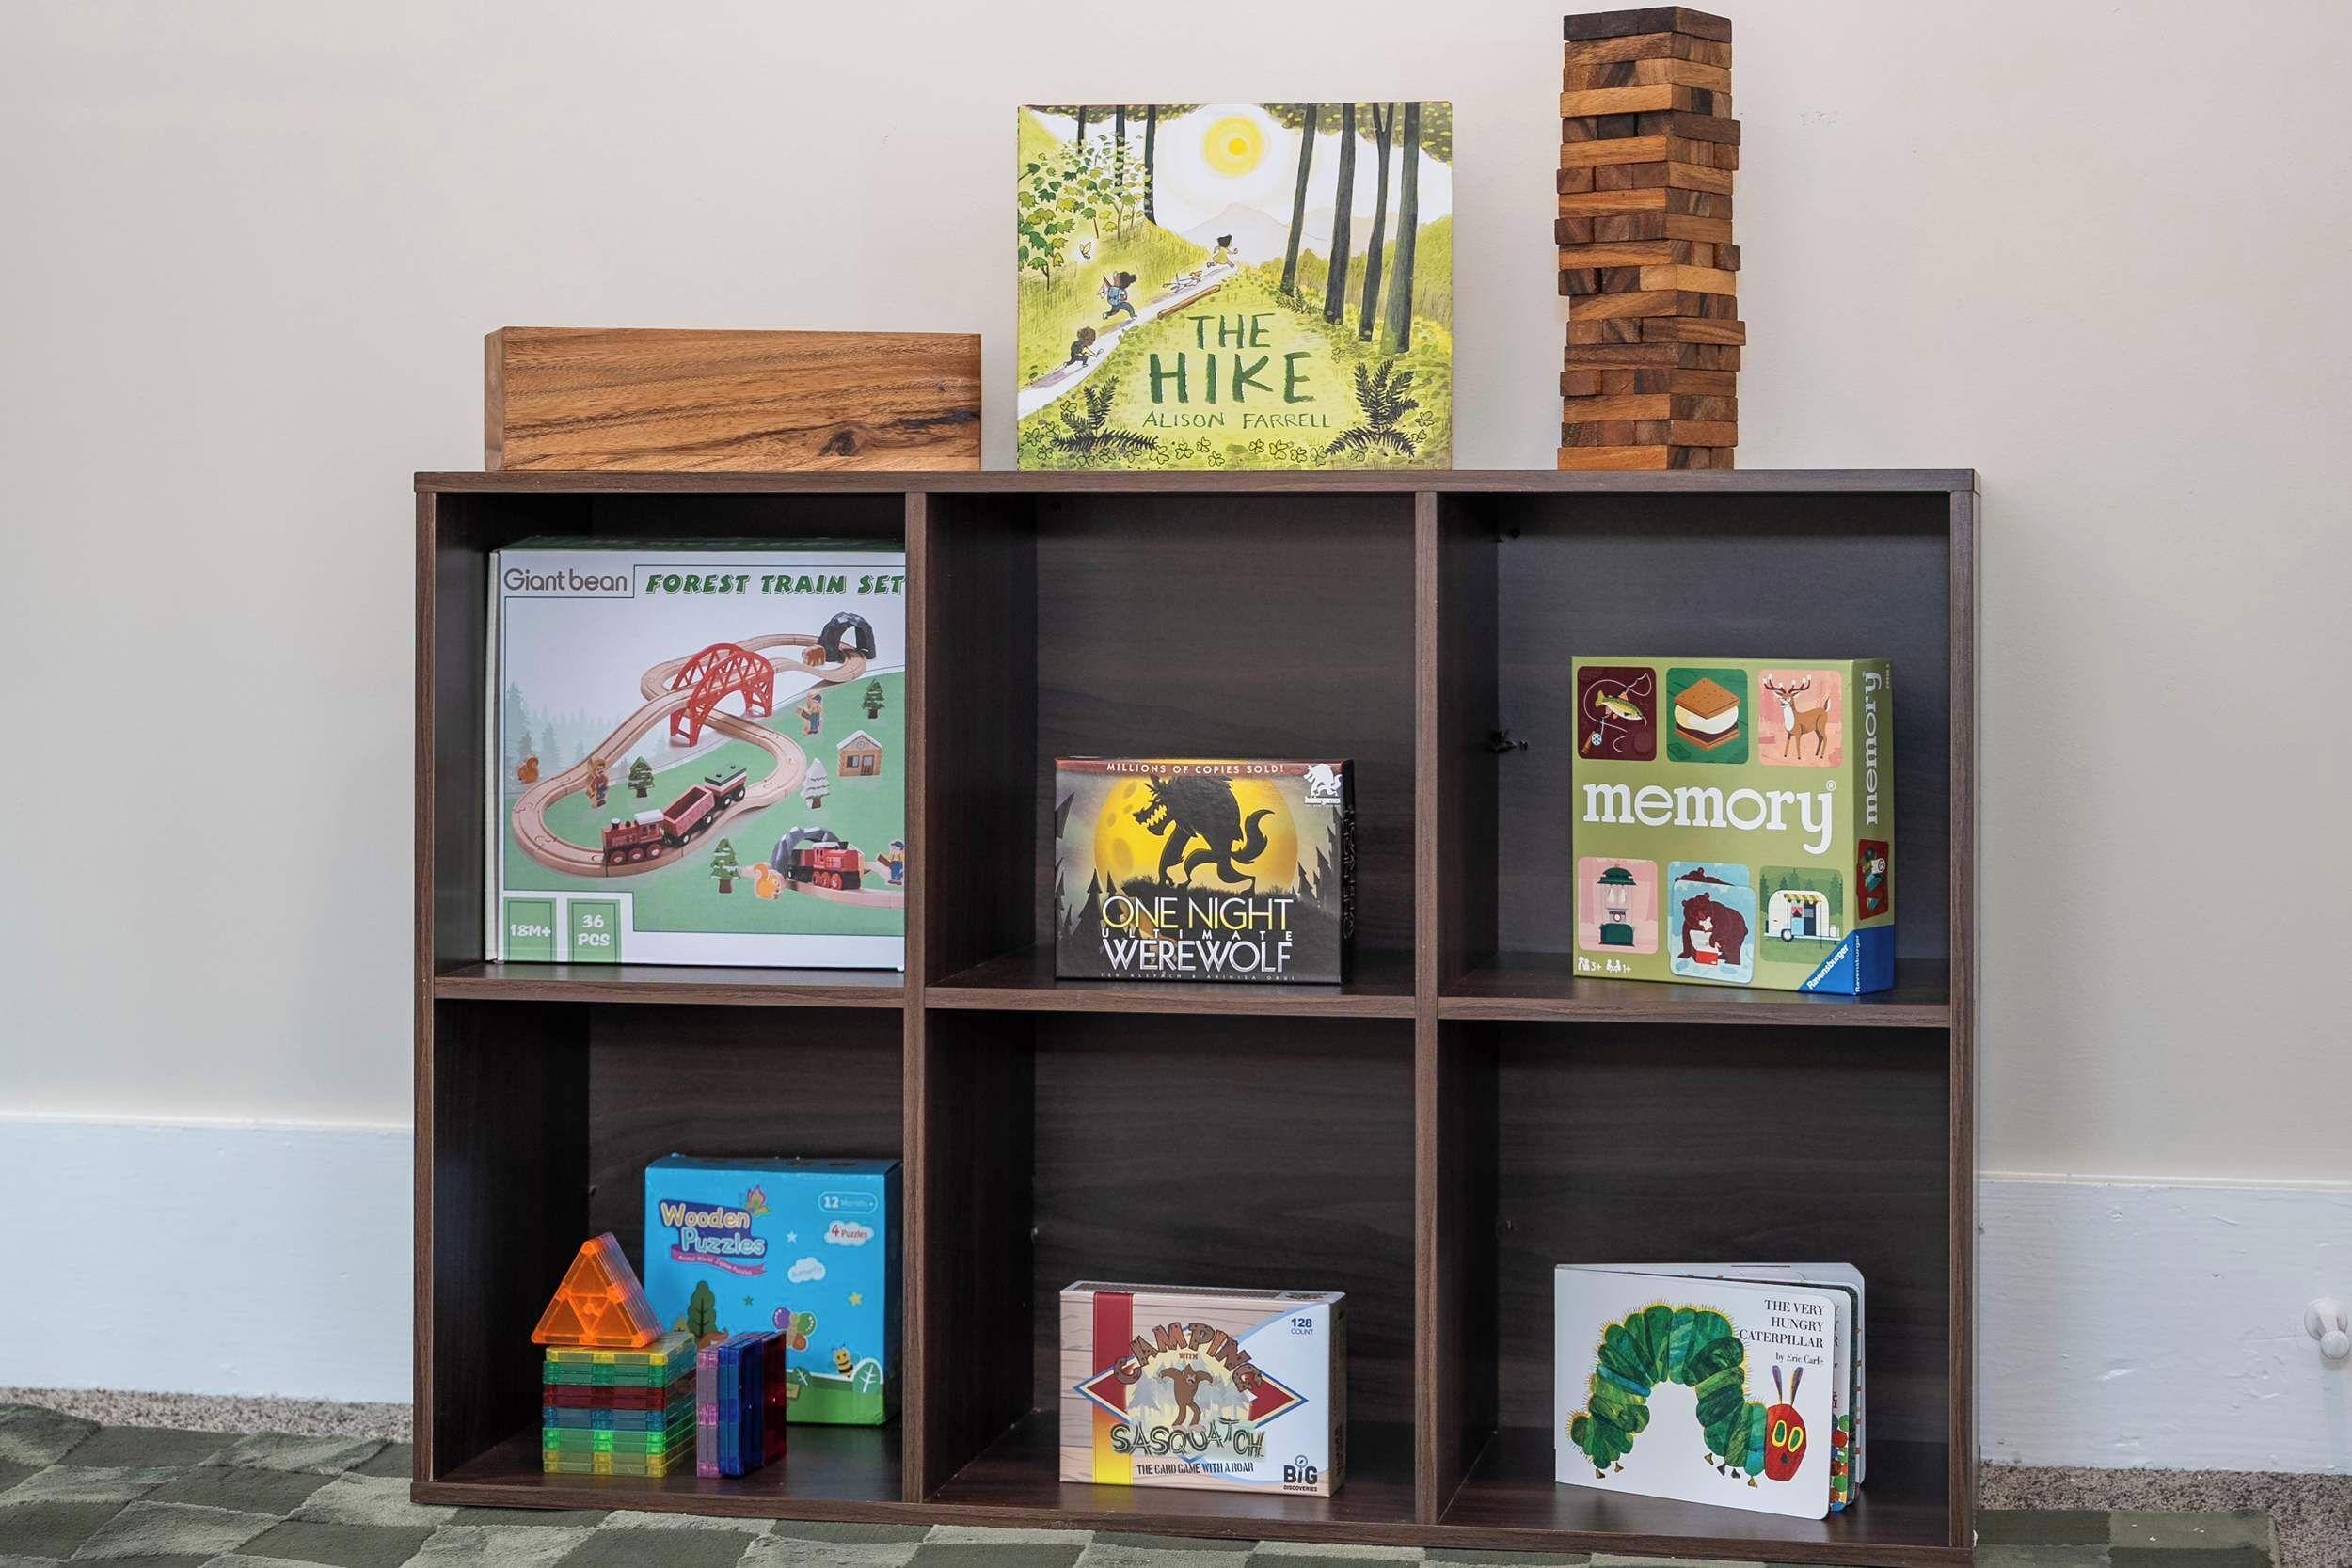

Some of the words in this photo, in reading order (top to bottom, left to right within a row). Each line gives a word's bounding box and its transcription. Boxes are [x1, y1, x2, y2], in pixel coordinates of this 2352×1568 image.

[1187, 312, 1276, 349] THE
[1149, 351, 1315, 404] HIKE
[1142, 411, 1225, 428] ALISON
[1243, 412, 1332, 429] FARRELL
[503, 568, 564, 592] Giant
[568, 568, 628, 592] bean
[646, 573, 750, 595] FOREST
[761, 574, 846, 595] TRAIN
[857, 574, 905, 595] SET
[1865, 672, 1883, 825] memory
[1106, 763, 1167, 774] MILLIONS
[1172, 765, 1189, 774] OF
[1195, 765, 1239, 775] COPIES
[1247, 765, 1284, 774] SOLD!
[582, 914, 604, 928] 36
[1102, 895, 1178, 929] ONE
[1188, 897, 1295, 930] NIGHT
[510, 924, 552, 937] 18M+
[578, 933, 610, 946] PCS
[1102, 928, 1293, 942] ULTIMATE
[1102, 939, 1293, 973] WEREWOLF
[1806, 943, 1849, 990] Ravensburger
[823, 1196, 839, 1209] 12
[660, 1202, 750, 1228] Wooden
[832, 1224, 840, 1237] 4
[841, 1229, 867, 1239] Puzzles
[681, 1227, 766, 1255] Puzzles
[1764, 1299, 1791, 1313] THE
[1793, 1302, 1825, 1316] VERY
[1291, 1318, 1312, 1328] 128
[1772, 1316, 1825, 1333] HUNGRY
[1740, 1328, 1824, 1349] CATERPILLAR
[1114, 1322, 1263, 1392] CAMPING
[1776, 1352, 1785, 1363] by
[1787, 1353, 1803, 1363] Eric
[1110, 1417, 1263, 1458] SASQUATCH
[1136, 1464, 1152, 1475] THE
[1154, 1464, 1177, 1475] CARD
[1178, 1463, 1200, 1474] GAME
[1201, 1463, 1223, 1474] WITH
[1231, 1462, 1254, 1473] ROAR
[1283, 1484, 1318, 1493] DISCOVERIES
